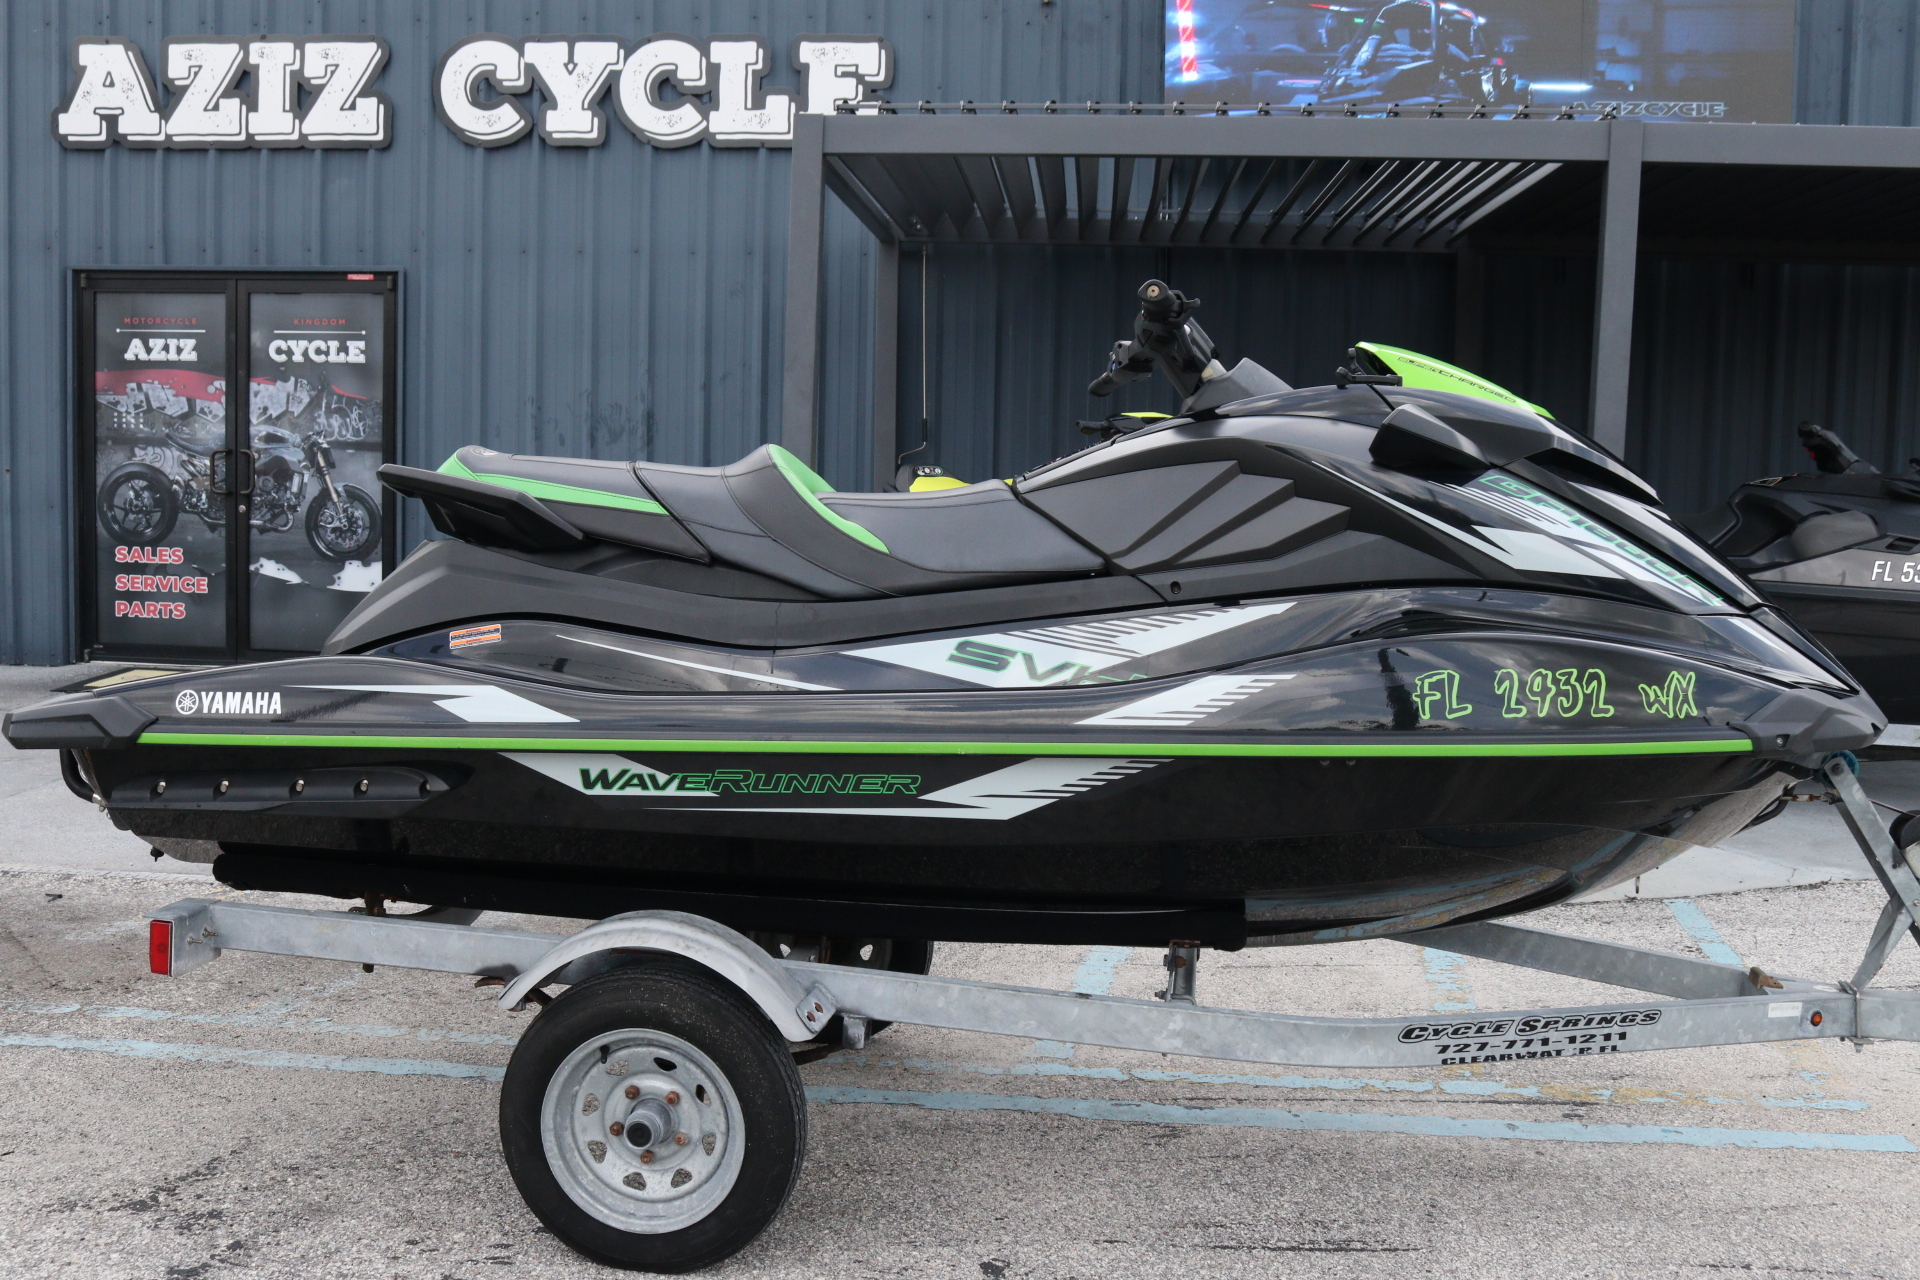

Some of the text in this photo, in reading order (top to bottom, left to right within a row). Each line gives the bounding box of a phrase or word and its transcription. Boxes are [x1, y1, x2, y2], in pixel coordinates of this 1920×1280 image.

[57, 38, 887, 141] AZIZ CYCLE
[123, 317, 198, 325] MOTORCYCLE
[293, 318, 346, 326] KINGDOM
[124, 338, 198, 361] AZIZ
[268, 339, 366, 363] CYCLE
[115, 546, 184, 564] SALES
[1871, 560, 1893, 582] FL
[115, 574, 208, 593] SERVICE
[115, 600, 186, 619] PARTS
[200, 691, 282, 715] YAMAHA
[1413, 670, 1473, 719] FL
[1435, 1031, 1627, 1055] 727-771-1211
[1441, 1044, 1621, 1065] CLEARWATR FL
